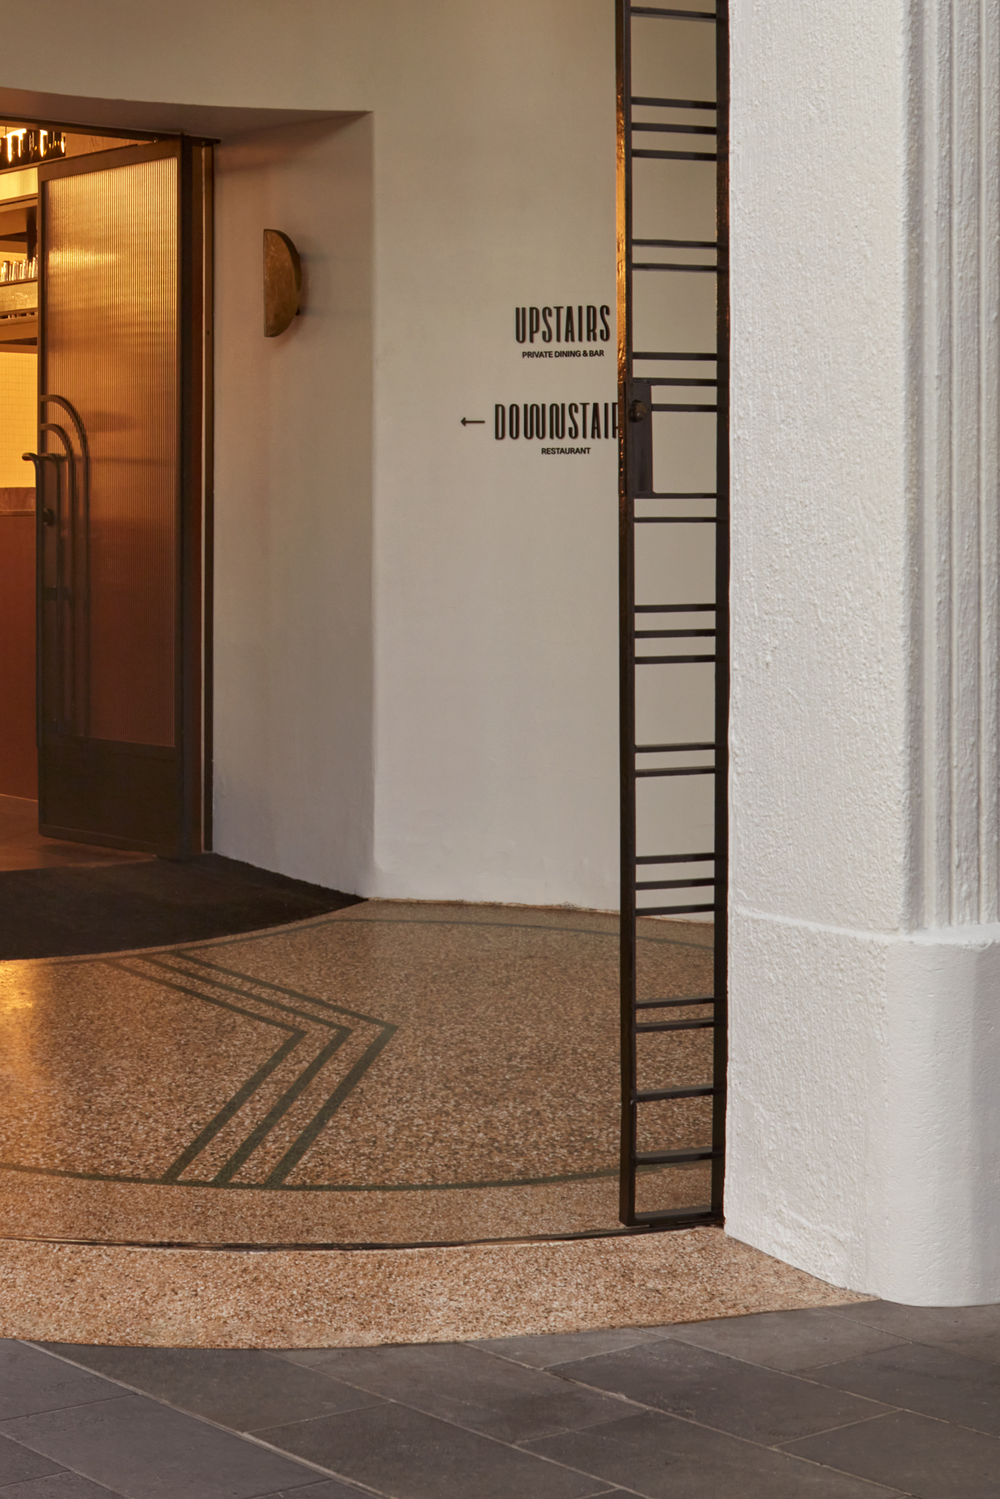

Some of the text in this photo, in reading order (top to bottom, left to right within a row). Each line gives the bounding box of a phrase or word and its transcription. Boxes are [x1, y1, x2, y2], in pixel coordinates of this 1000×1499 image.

[515, 304, 611, 344] UPSTAIRS
[521, 349, 605, 359] PRIVATE DINING & BAR
[494, 402, 619, 441] DOWNSTAIR
[541, 447, 592, 455] RESTAURANT
